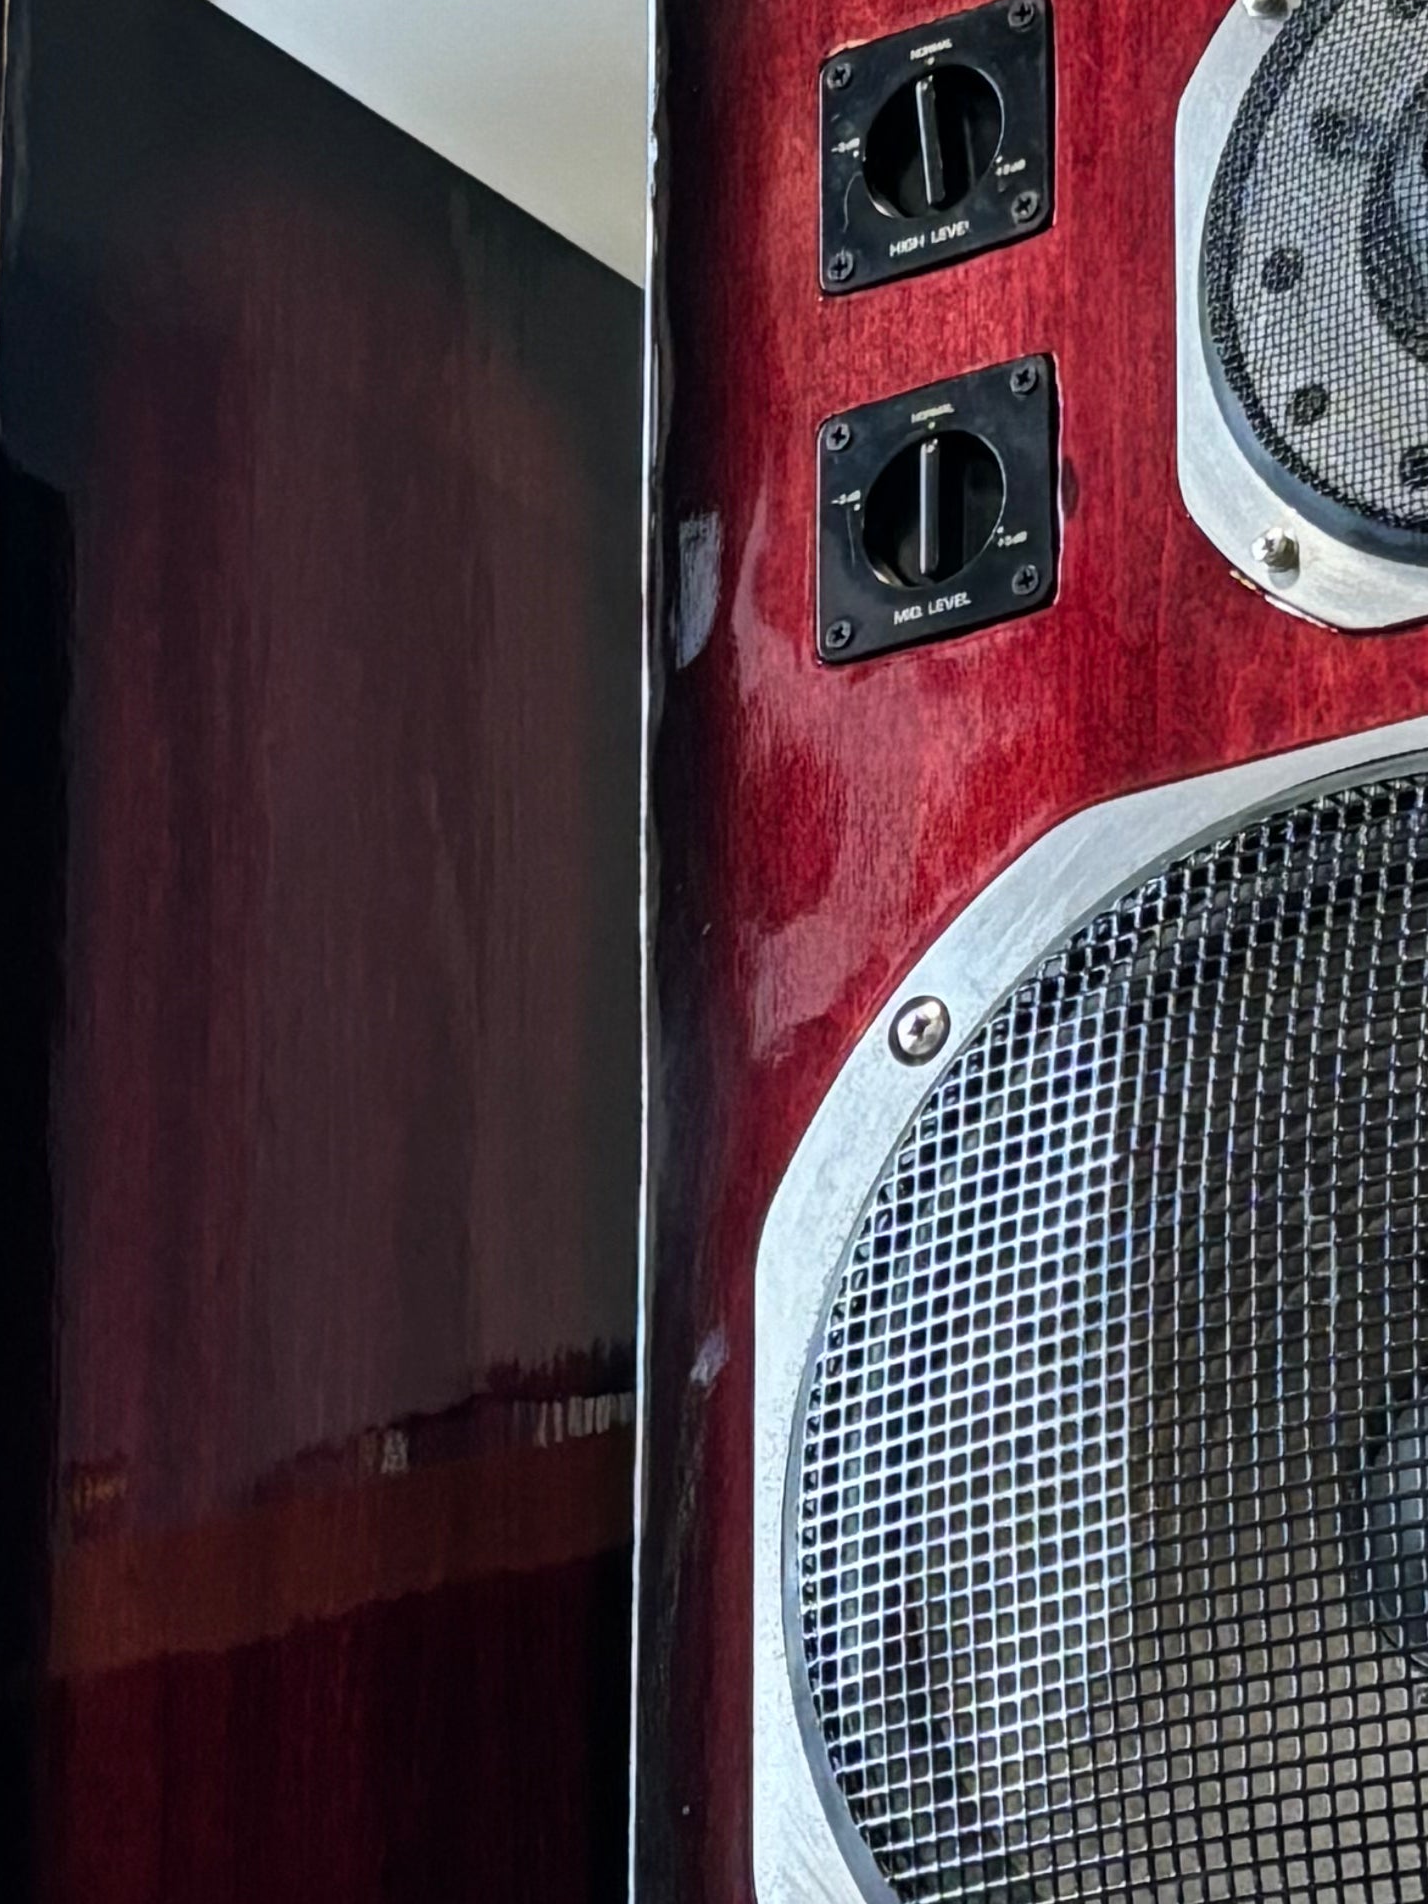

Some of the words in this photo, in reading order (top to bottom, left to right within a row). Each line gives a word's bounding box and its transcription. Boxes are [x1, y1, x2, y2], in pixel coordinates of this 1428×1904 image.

[889, 234, 925, 257] HIGH
[931, 219, 970, 244] LEVEL
[928, 591, 972, 616] LEVEL
